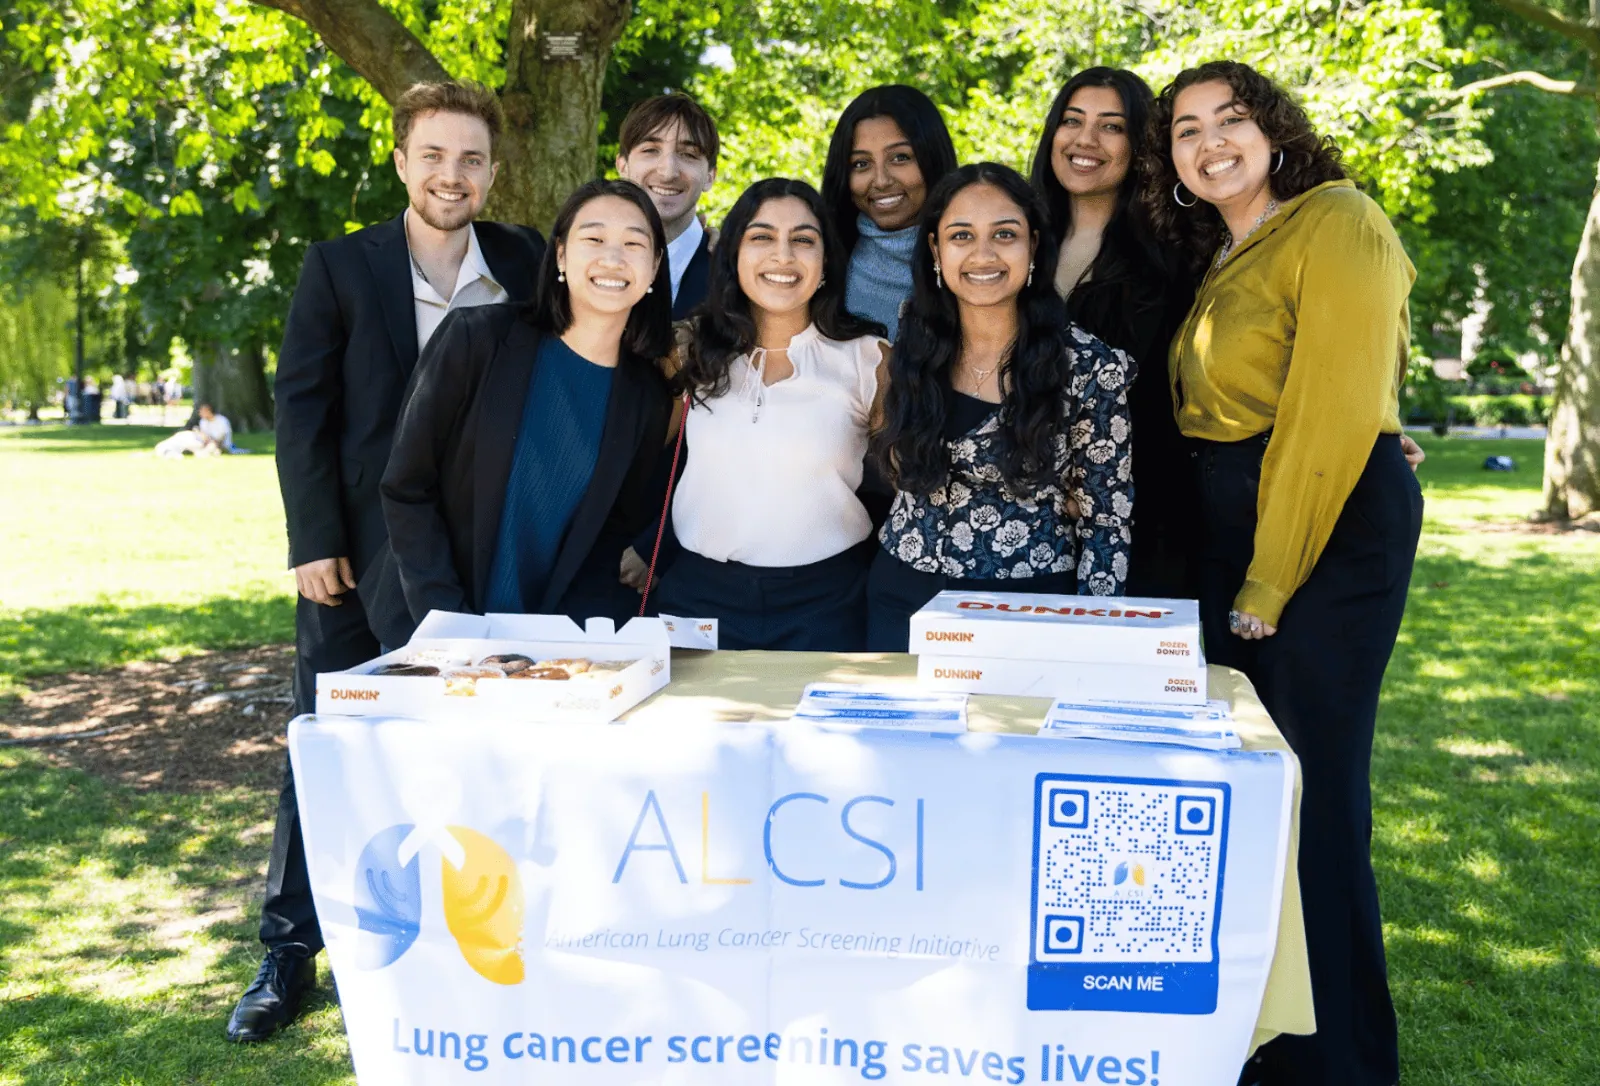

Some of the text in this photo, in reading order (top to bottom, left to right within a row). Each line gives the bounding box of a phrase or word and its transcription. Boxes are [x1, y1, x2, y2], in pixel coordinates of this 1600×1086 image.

[957, 601, 1174, 618] DUNKIN'
[926, 631, 974, 642] DUNKIN'
[1156, 648, 1190, 656] DONUTS
[934, 668, 982, 680] DUNKIN'
[611, 789, 925, 891] ALCSI
[1114, 889, 1144, 897] ACSI
[656, 928, 710, 951] Lung
[717, 927, 791, 948] Cancer
[797, 927, 902, 953] Screening
[908, 933, 1001, 961] Initiative
[1083, 974, 1164, 991] SCAN ME
[392, 1018, 1160, 1086] Lung cancer screening saves lives!
